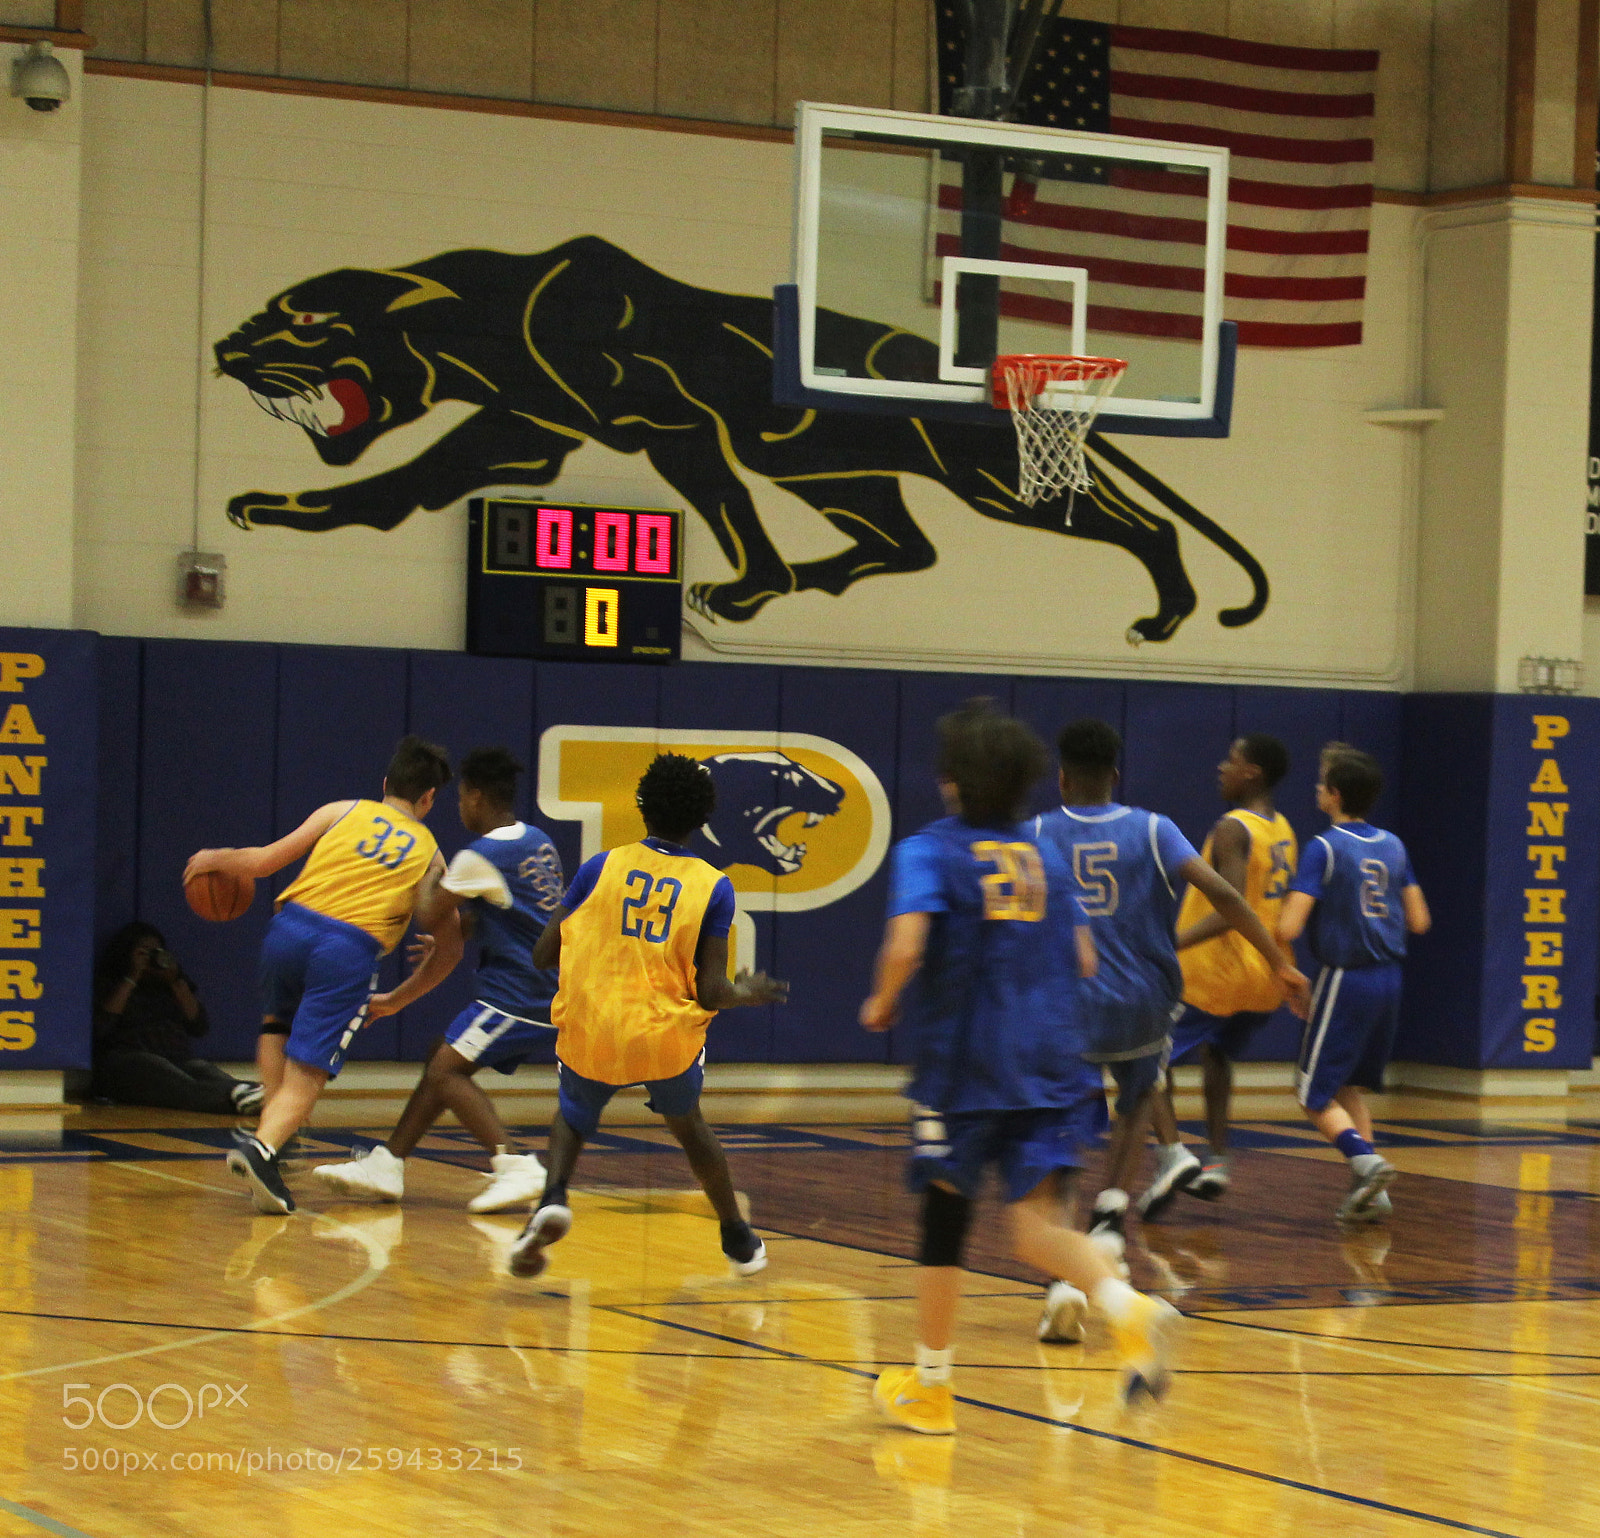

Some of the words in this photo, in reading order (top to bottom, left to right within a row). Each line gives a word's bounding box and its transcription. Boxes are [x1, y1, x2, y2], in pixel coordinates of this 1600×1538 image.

[536, 508, 671, 574] 0:00
[585, 587, 619, 647] 0
[0, 651, 47, 1051] PANTHERS
[355, 815, 416, 870] 33
[620, 868, 683, 944] 23
[1073, 841, 1119, 917] 5
[1360, 858, 1390, 918] 2
[1521, 715, 1570, 1053] PANTHERS
